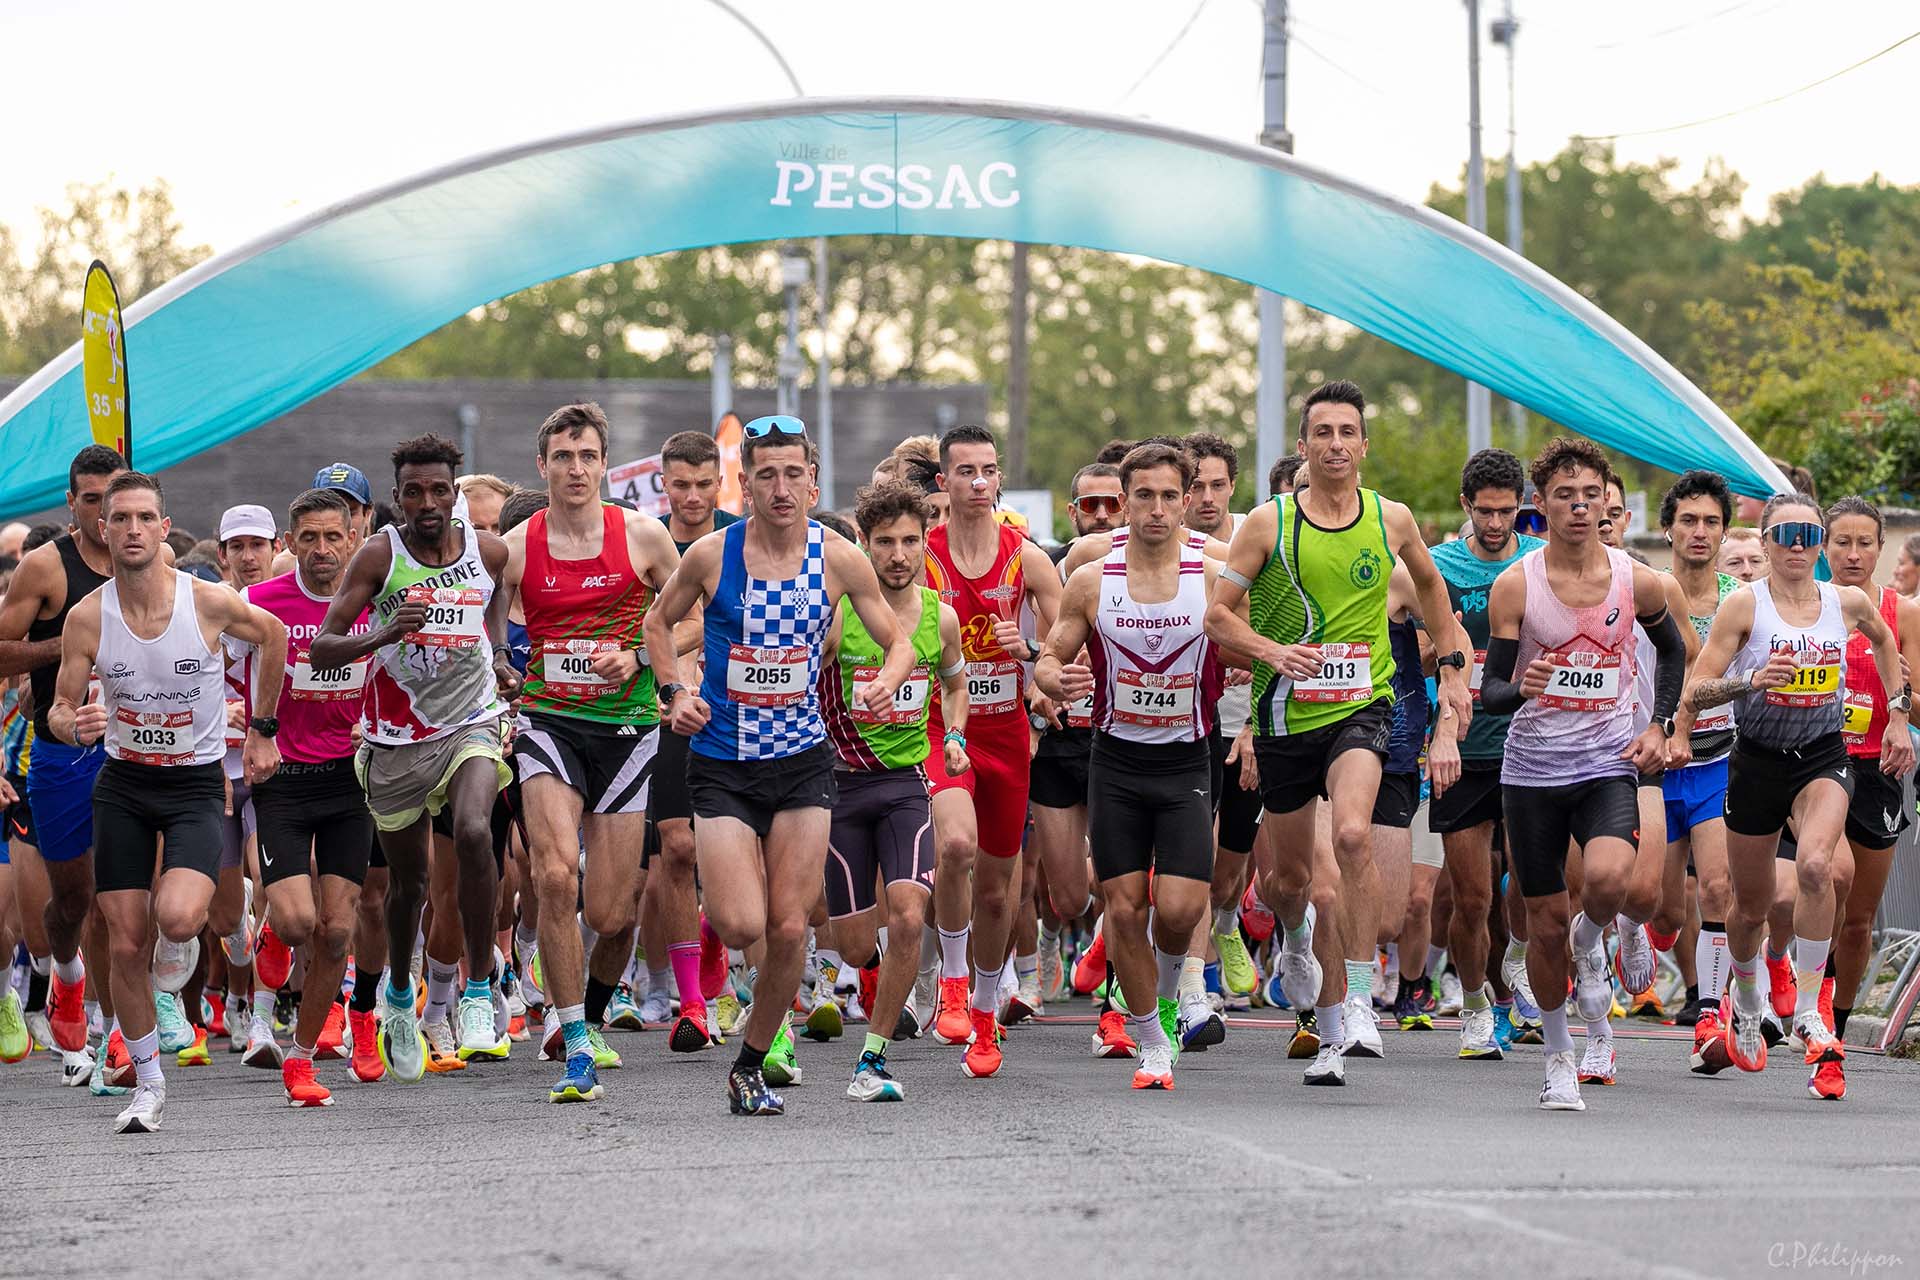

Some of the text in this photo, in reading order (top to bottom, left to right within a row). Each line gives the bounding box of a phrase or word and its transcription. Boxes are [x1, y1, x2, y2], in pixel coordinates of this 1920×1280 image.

[779, 142, 848, 160] Ville de
[770, 160, 1020, 209] PESSAC
[92, 392, 110, 416] 35
[380, 560, 480, 618] DOROGNE
[581, 575, 607, 588] PAC
[426, 607, 464, 625] 2031
[1116, 616, 1191, 629] BORDEAUX
[178, 662, 197, 671] 100%
[311, 667, 351, 682] 2006
[561, 658, 592, 674] 400
[744, 667, 791, 684] 2055
[1558, 670, 1604, 688] 2048
[1791, 669, 1826, 685] 119
[896, 685, 912, 701] 18
[968, 679, 1001, 696] 056
[1132, 690, 1176, 708] 3744
[132, 729, 176, 746] 2033
